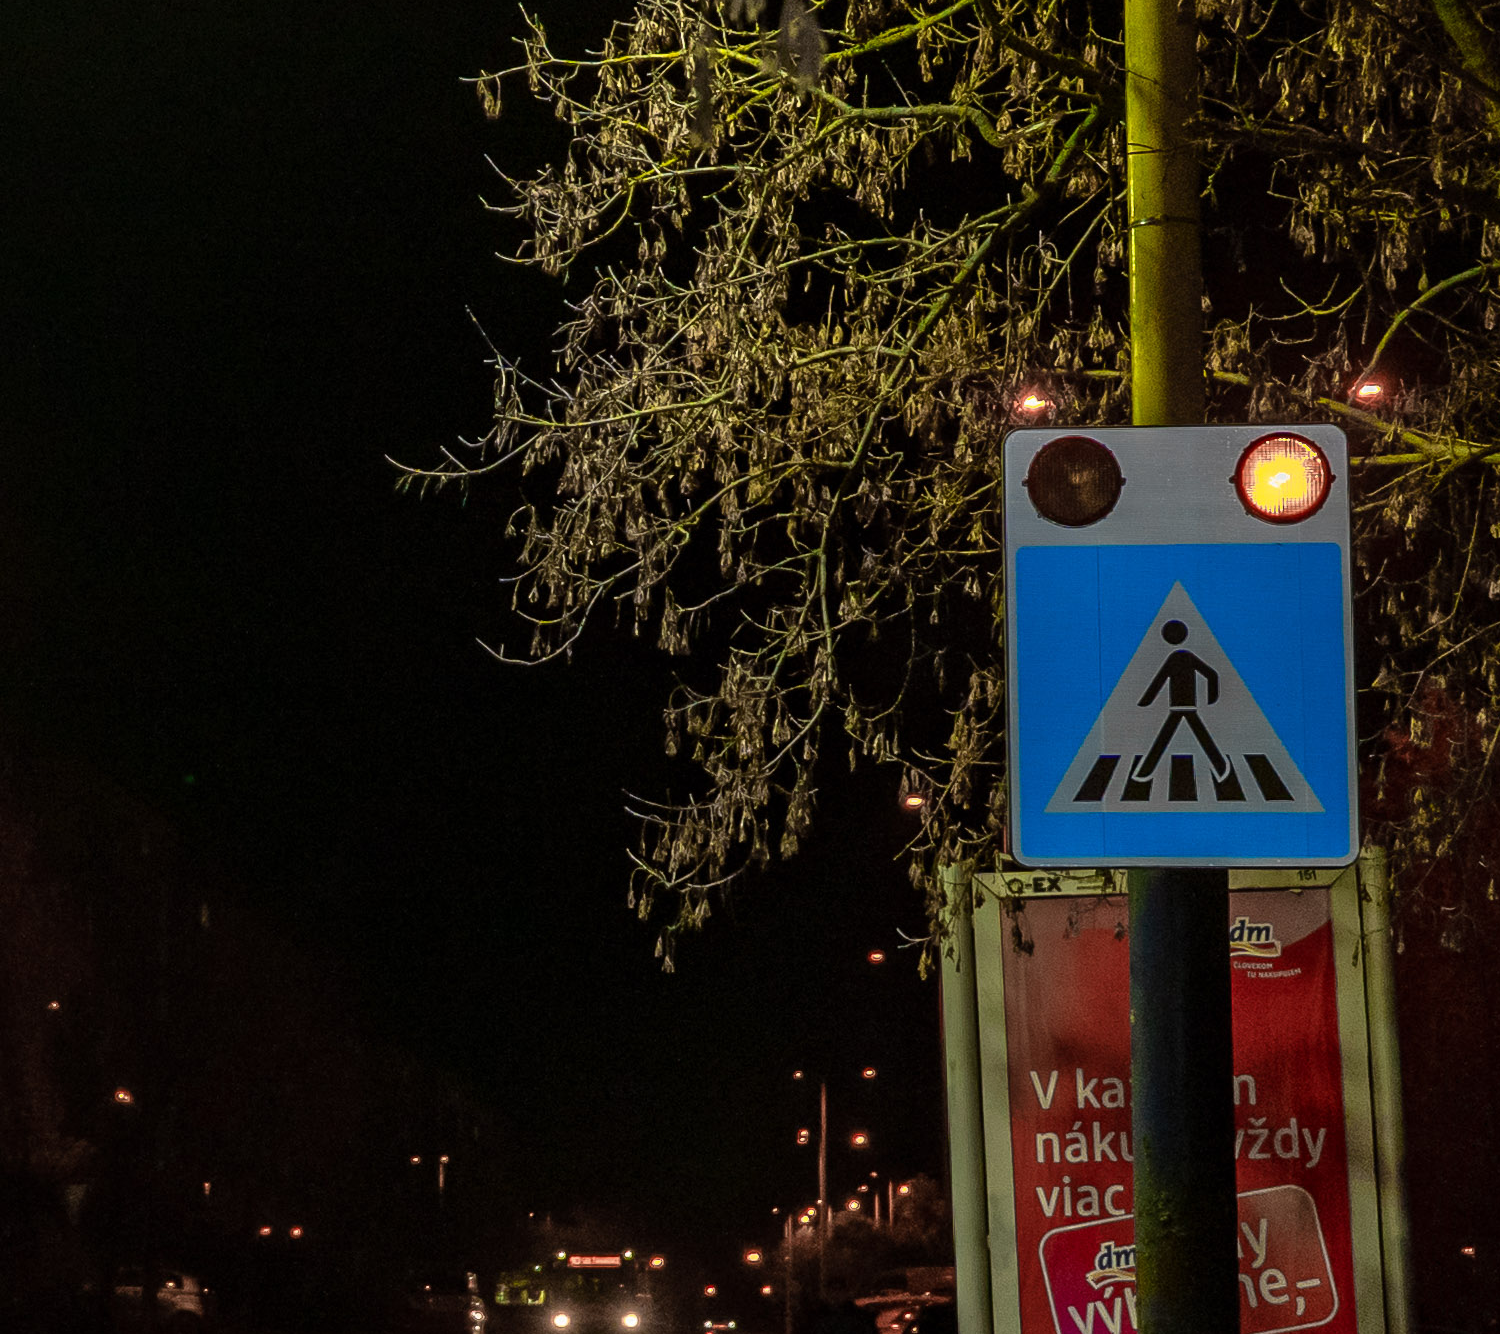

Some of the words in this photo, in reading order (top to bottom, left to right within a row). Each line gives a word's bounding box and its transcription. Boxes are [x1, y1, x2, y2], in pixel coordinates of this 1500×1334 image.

[1298, 870, 1317, 880] 151
[1230, 919, 1270, 942] dm
[1030, 1070, 1058, 1109] V
[1036, 1176, 1126, 1217] viac
[1098, 1245, 1136, 1270] dm
